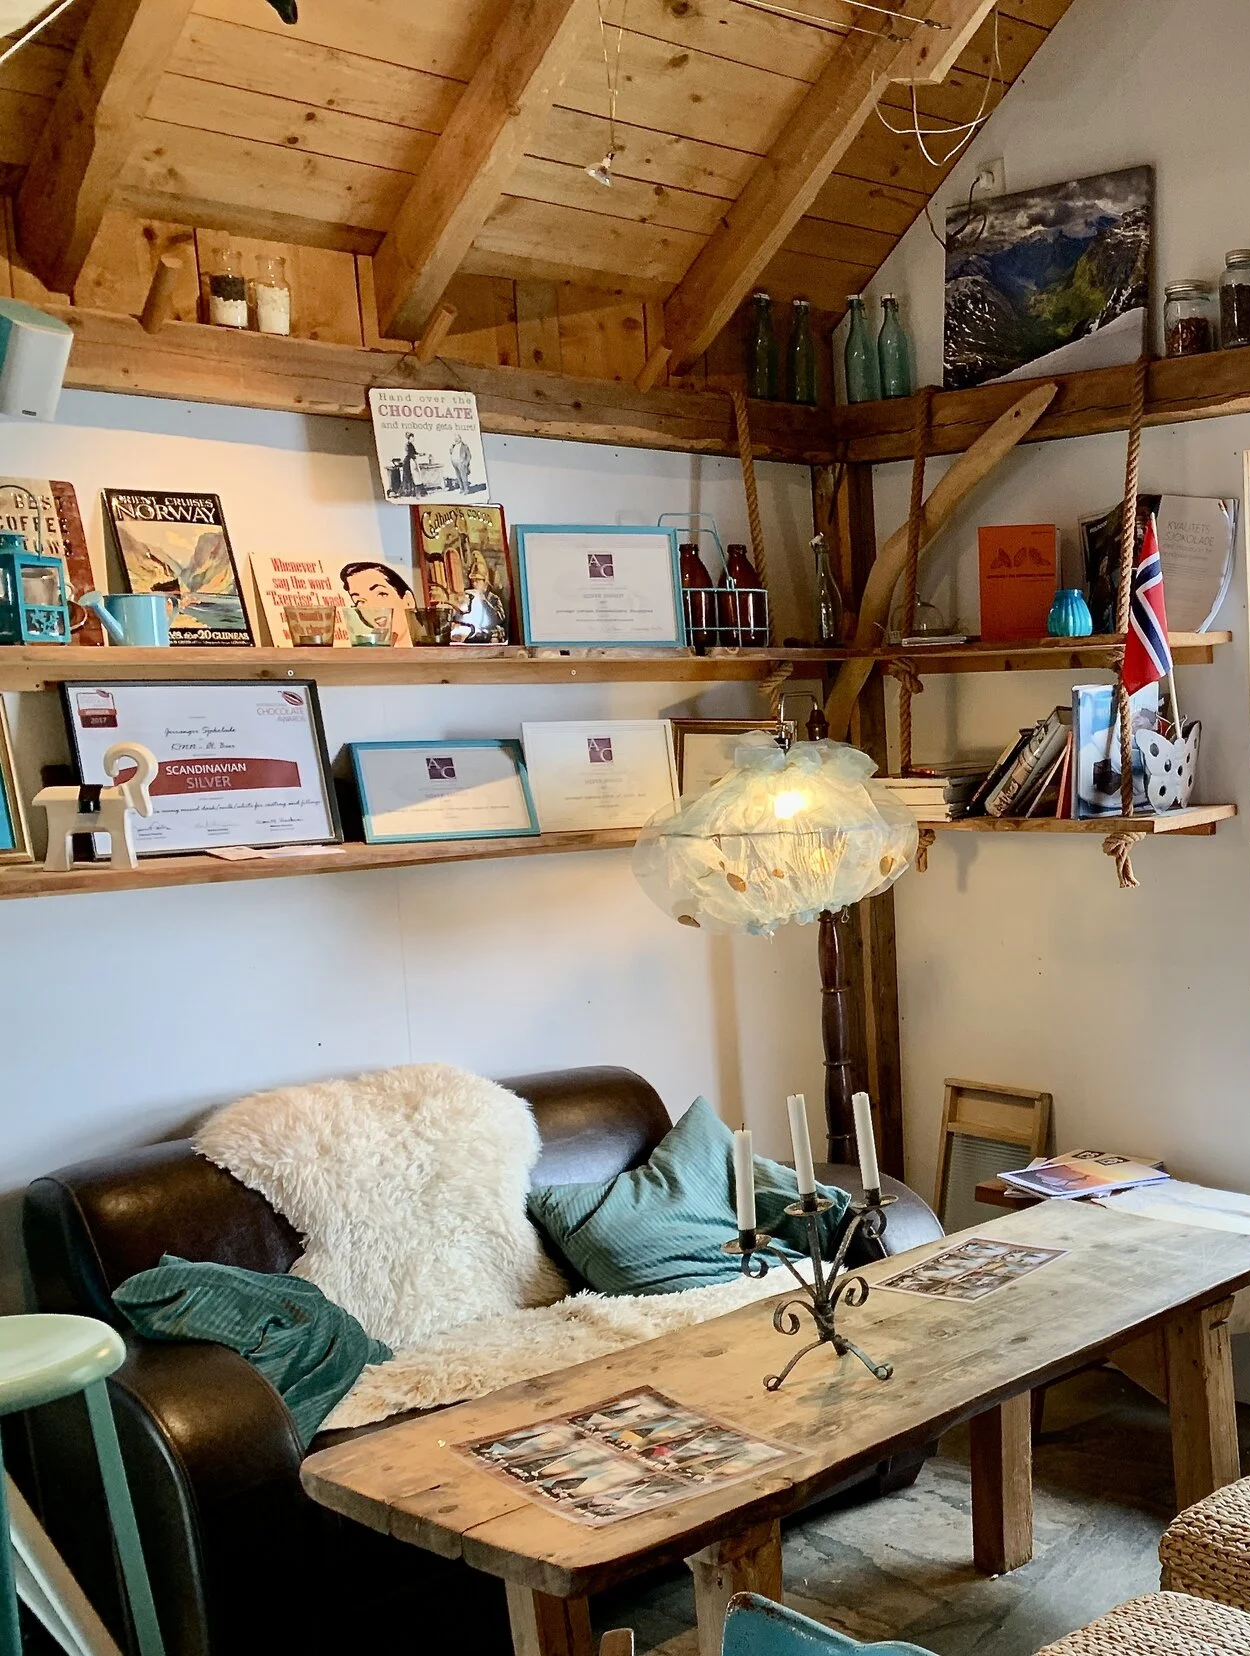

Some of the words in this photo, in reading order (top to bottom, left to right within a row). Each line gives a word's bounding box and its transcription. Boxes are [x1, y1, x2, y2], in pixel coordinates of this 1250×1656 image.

[378, 393, 412, 402] Hand
[419, 395, 445, 404] over
[452, 396, 472, 404] the
[378, 404, 474, 420] CHOCOLATE
[381, 421, 399, 430] and
[401, 421, 433, 431] nobody
[436, 423, 454, 432] gets
[117, 495, 157, 506] ORIENT
[164, 497, 214, 508] CRUISES
[113, 502, 216, 524] NORWAY
[270, 557, 317, 574] Whenever
[272, 577, 290, 592] say
[290, 575, 307, 590] the
[308, 576, 332, 591] word
[322, 593, 346, 607] wash
[197, 629, 211, 640] 20
[212, 631, 250, 641] GUINEAS
[165, 763, 247, 776] SCANDINAVIAN
[186, 775, 232, 789] SILVER
